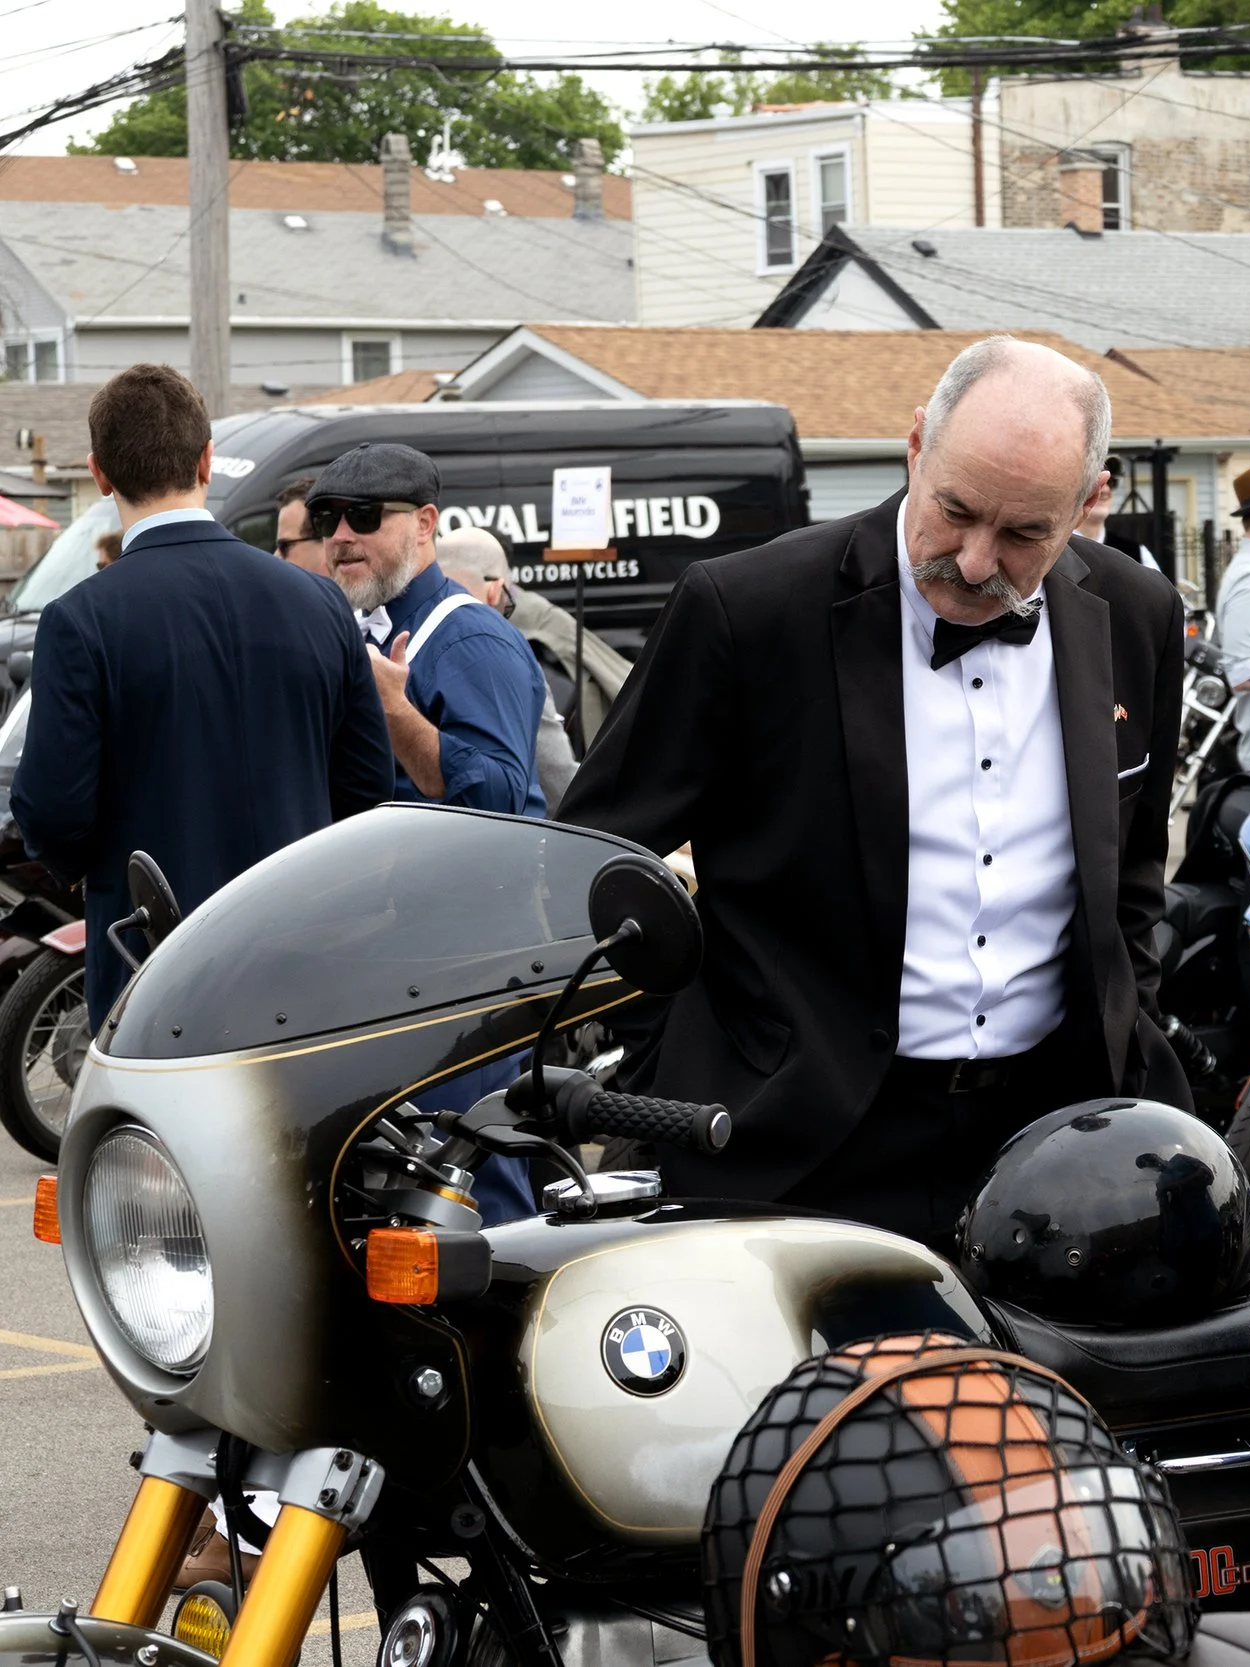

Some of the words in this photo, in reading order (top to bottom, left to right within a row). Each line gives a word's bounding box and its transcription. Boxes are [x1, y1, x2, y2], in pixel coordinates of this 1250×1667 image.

[436, 503, 549, 543] OYAL
[607, 495, 721, 539] FIELD
[609, 1312, 675, 1344] BMW
